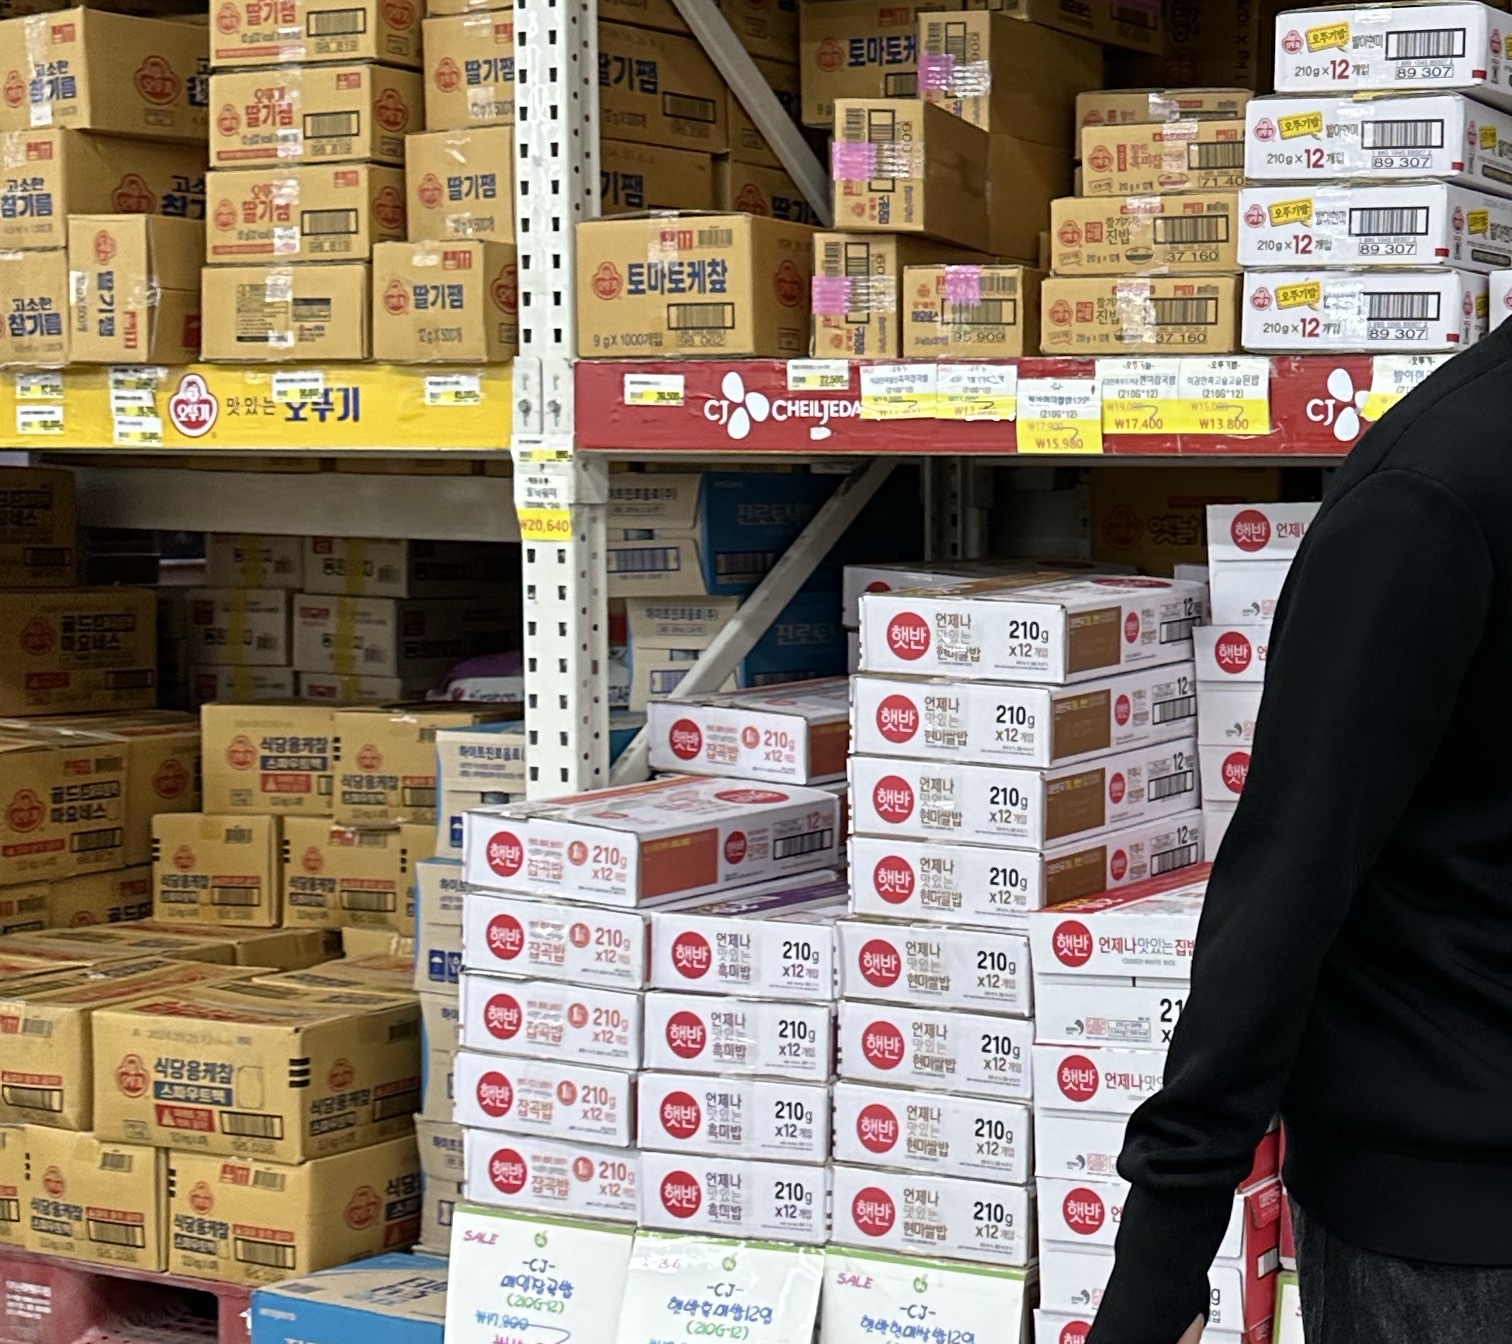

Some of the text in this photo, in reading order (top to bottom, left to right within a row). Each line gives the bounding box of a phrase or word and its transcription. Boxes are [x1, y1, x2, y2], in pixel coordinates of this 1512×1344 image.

[1308, 29, 1350, 47] 오뚜기밥
[1396, 65, 1453, 79] 89 307
[6, 177, 44, 192] 고소한
[1, 193, 52, 218] 참기름
[12, 297, 52, 312] 고소한
[8, 312, 62, 337] 참기름
[175, 401, 212, 422] 오뚜기
[225, 394, 275, 418] 맛있는
[704, 399, 861, 425] CJ CHEILJEDA
[1307, 398, 1336, 426] CJ
[935, 613, 971, 630] 언제나
[891, 626, 927, 650] 햇반
[1009, 620, 1049, 643] 210g
[489, 850, 520, 868] 햇반
[716, 933, 751, 949] 언제나
[463, 1230, 499, 1245] SALE
[837, 1272, 874, 1290] SALE
